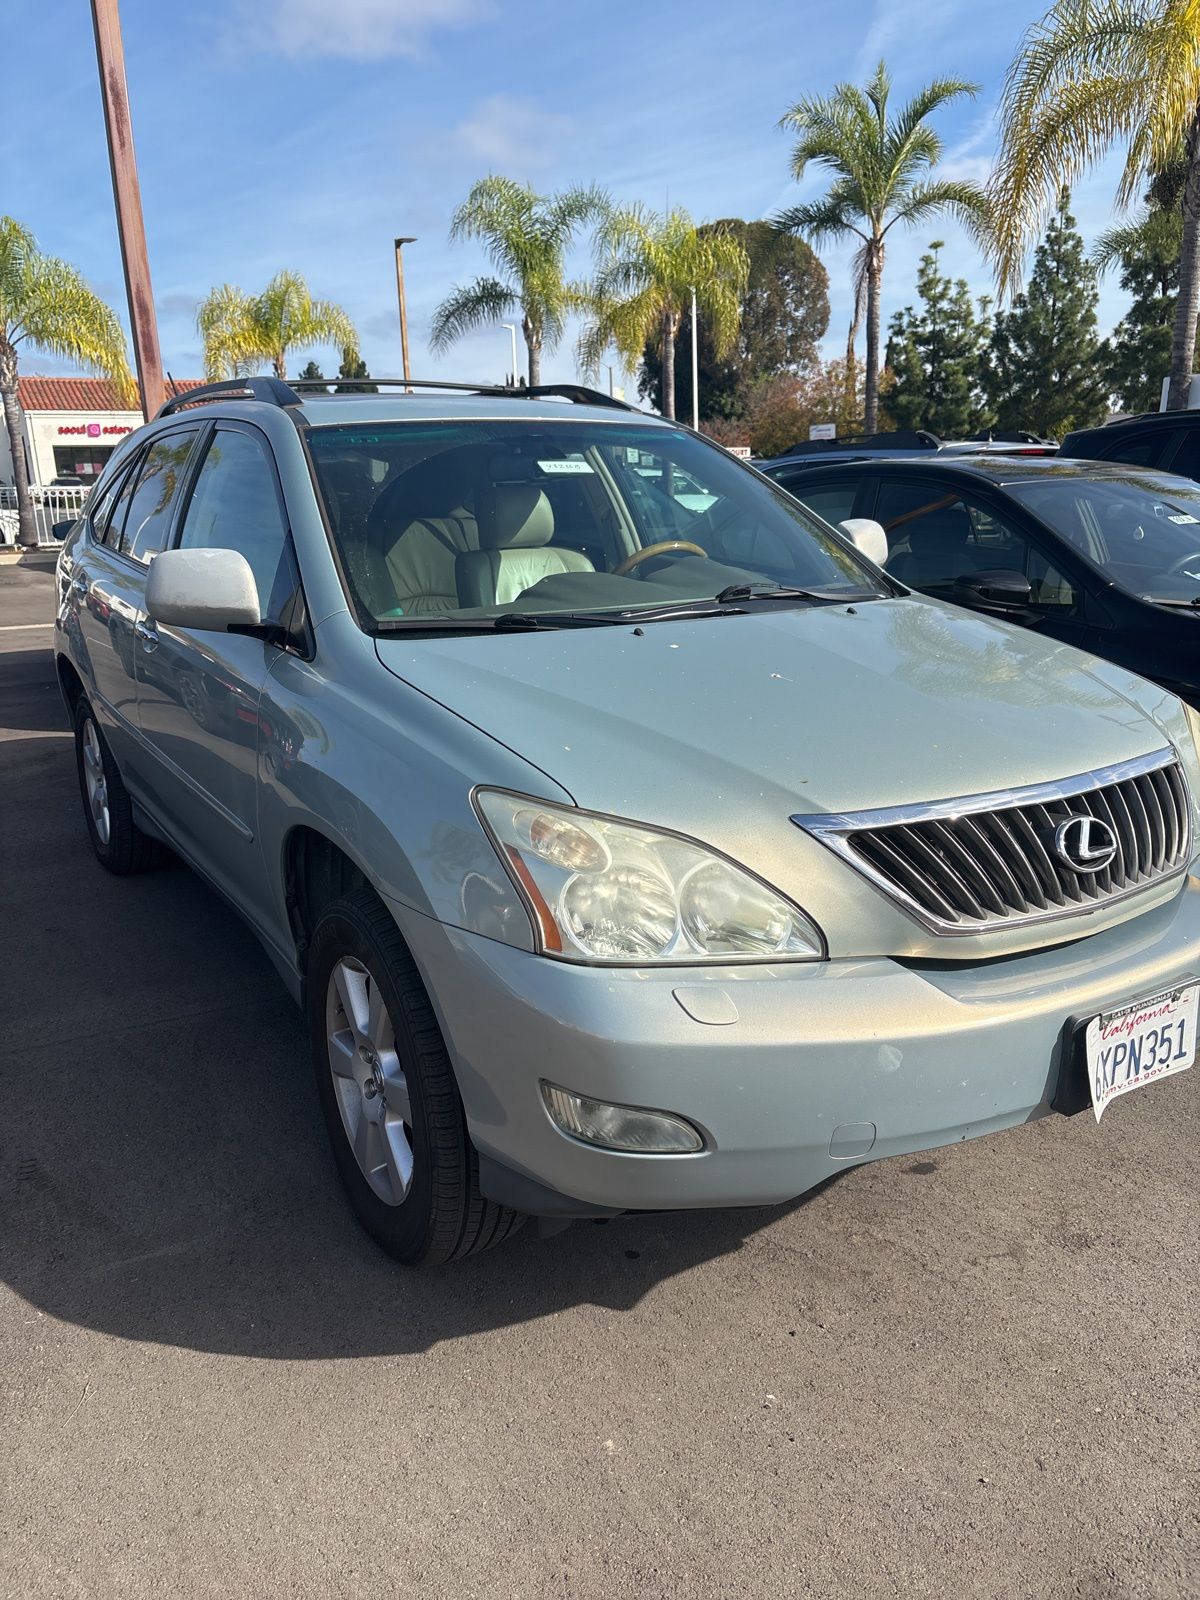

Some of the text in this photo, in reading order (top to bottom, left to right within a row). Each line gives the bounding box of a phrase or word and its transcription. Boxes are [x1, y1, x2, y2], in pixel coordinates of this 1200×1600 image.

[58, 424, 133, 435] seoul eatery
[1101, 1002, 1178, 1040] California
[1095, 1018, 1187, 1102] 6XPN351
